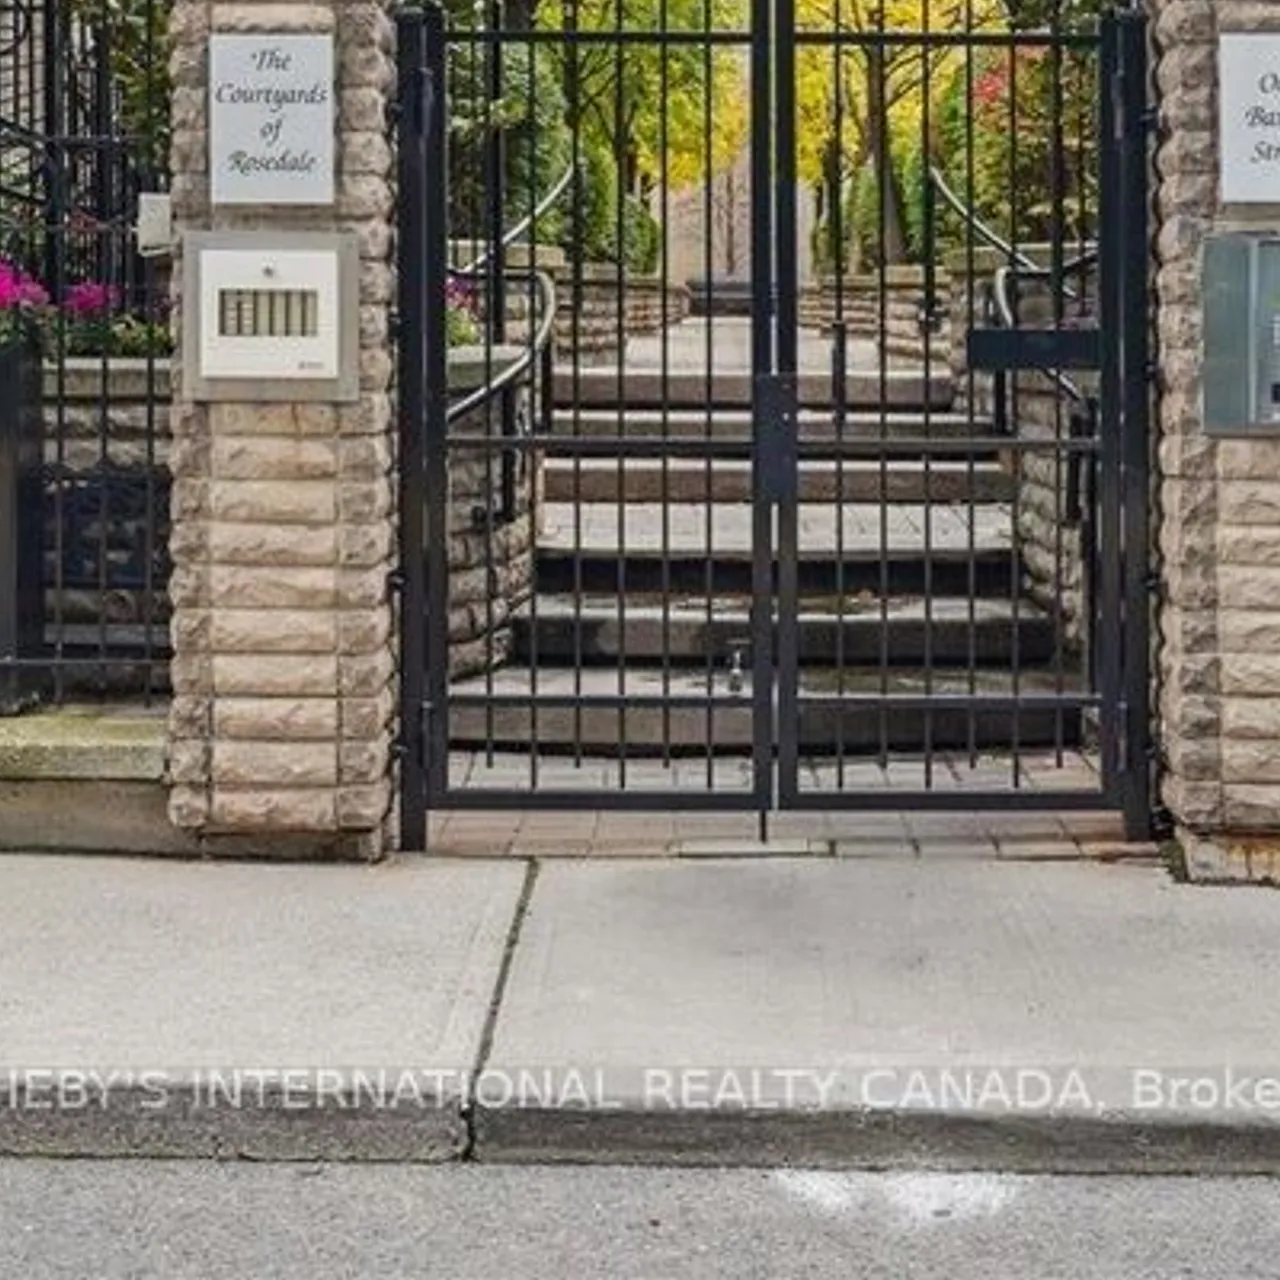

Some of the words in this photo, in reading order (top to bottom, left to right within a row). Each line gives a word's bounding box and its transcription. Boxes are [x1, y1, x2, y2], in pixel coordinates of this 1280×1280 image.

[250, 49, 293, 72] The
[215, 84, 327, 112] Courtyards
[259, 118, 284, 145] of
[227, 149, 317, 175] Rosedale
